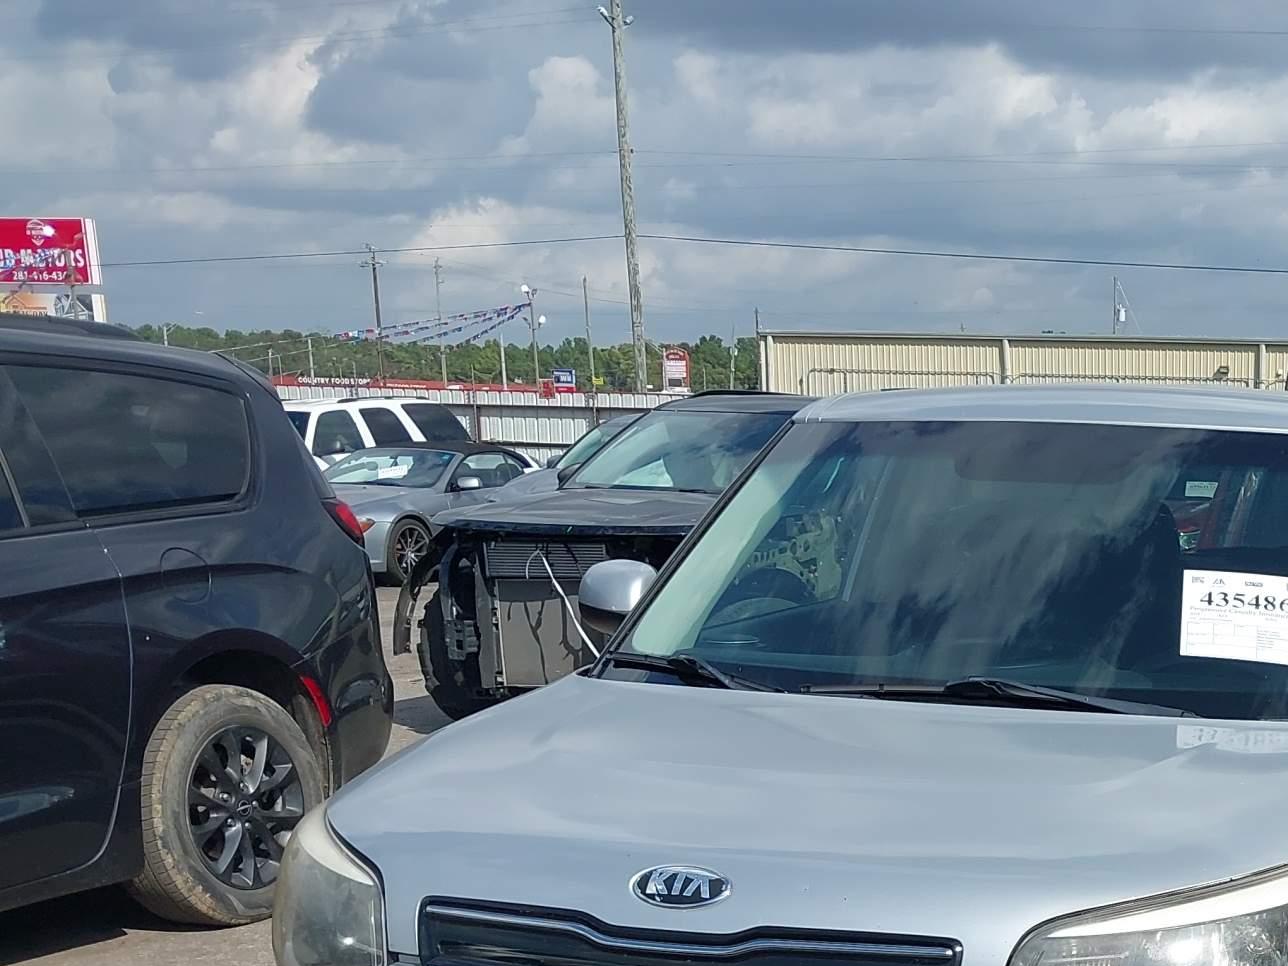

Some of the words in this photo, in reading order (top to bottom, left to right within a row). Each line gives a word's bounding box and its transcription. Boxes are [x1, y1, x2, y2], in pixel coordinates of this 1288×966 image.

[297, 376, 329, 386] COUNTRY
[331, 377, 350, 386] FOOD
[645, 868, 711, 899] KIA
